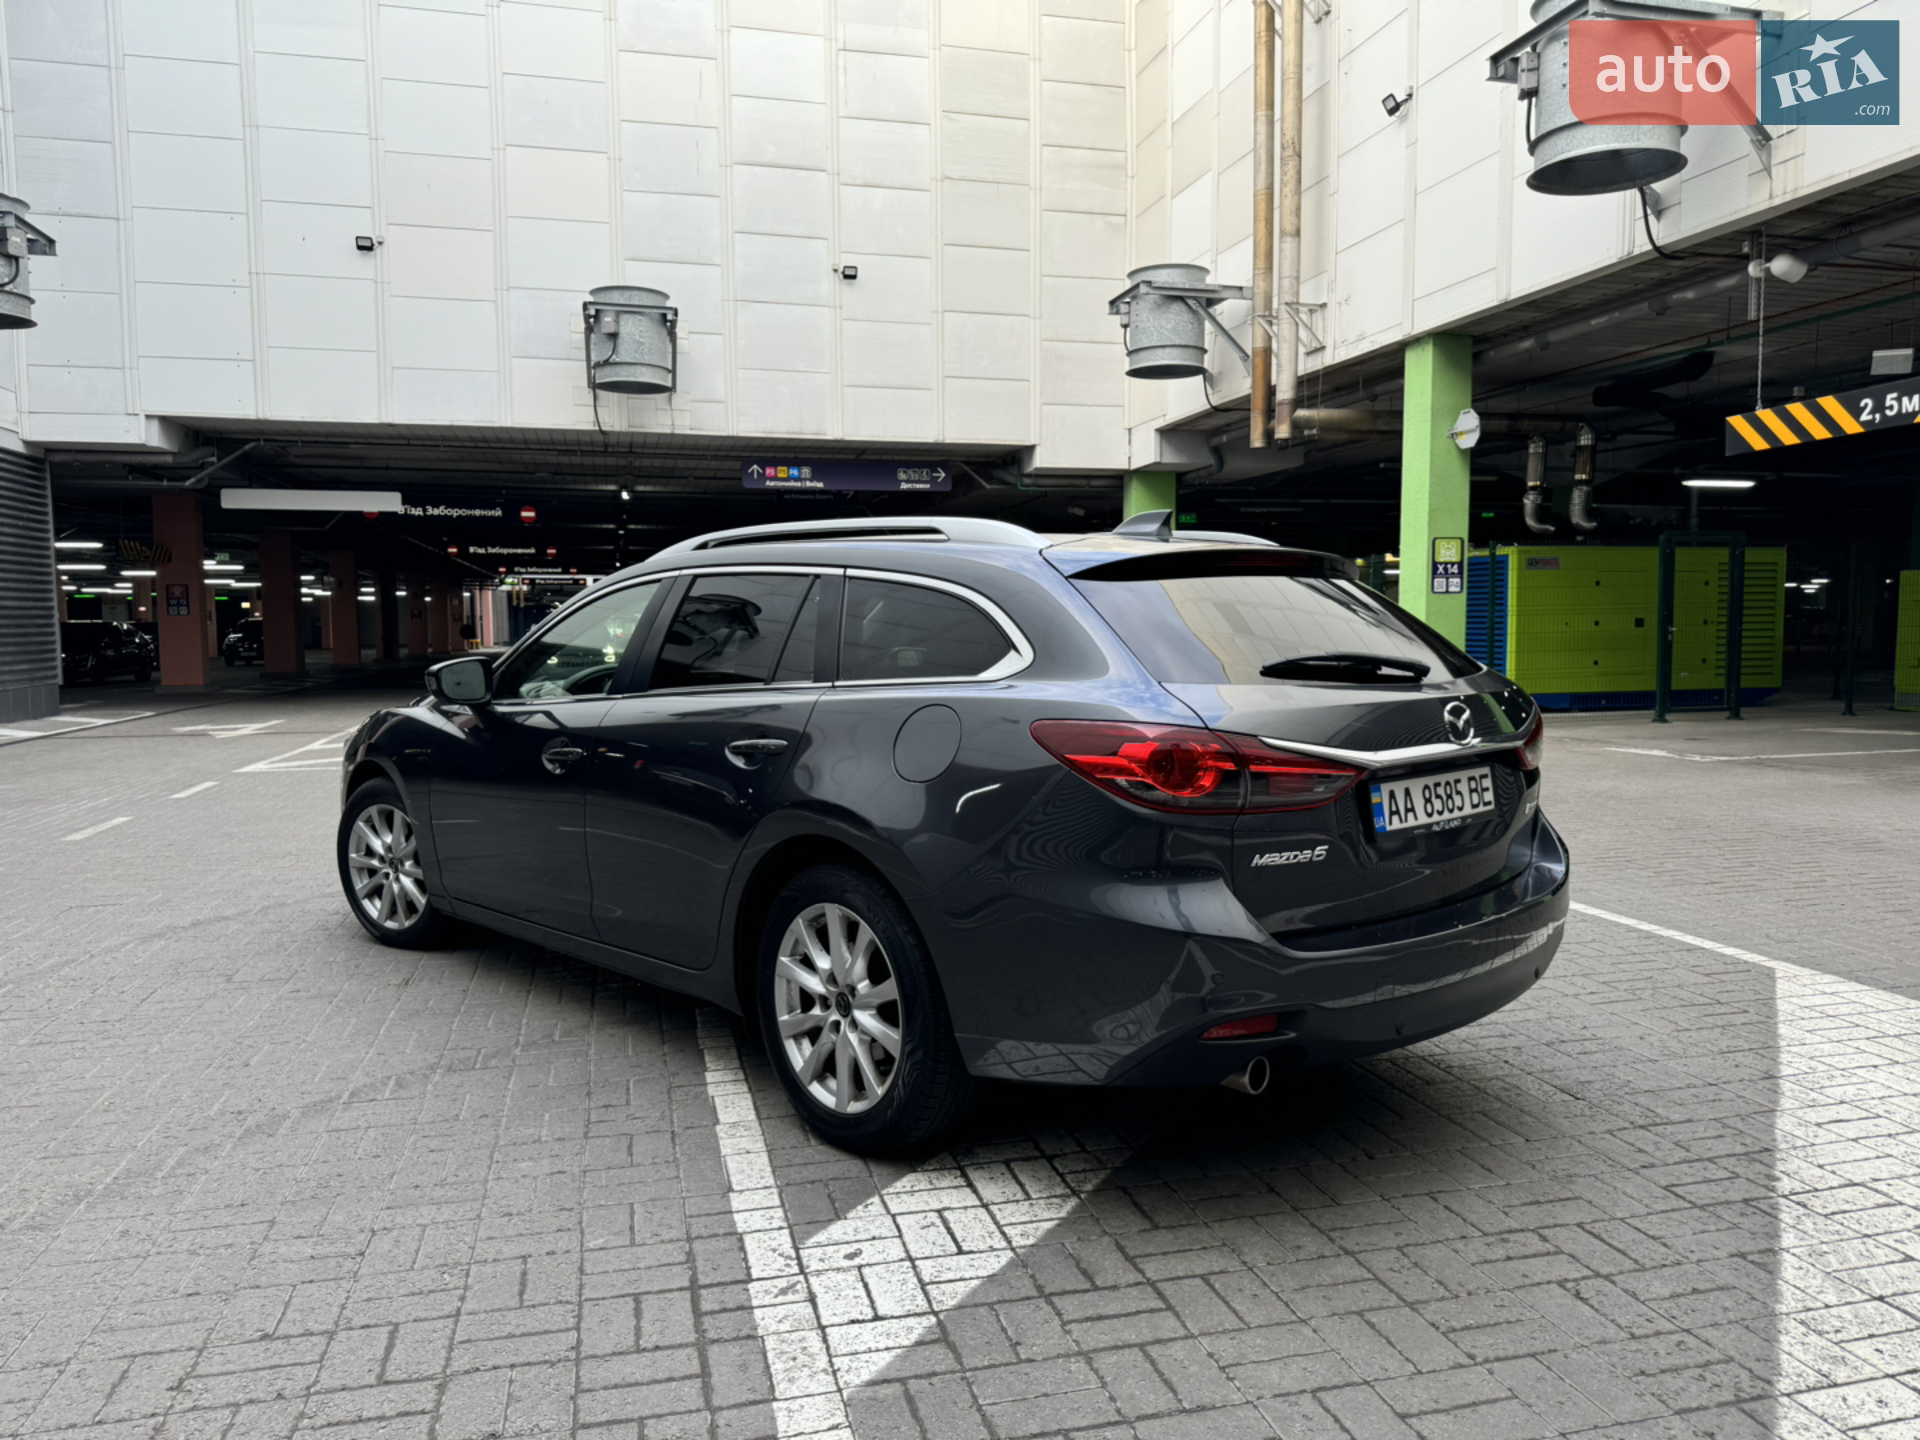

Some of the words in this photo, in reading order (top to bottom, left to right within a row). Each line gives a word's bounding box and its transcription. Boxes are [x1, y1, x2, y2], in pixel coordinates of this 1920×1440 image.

[425, 505, 503, 518] Заборонений
[487, 546, 536, 555] Заборонений
[1446, 563, 1459, 574] 14
[1388, 786, 1419, 826] AA
[1422, 778, 1465, 818] 8585
[1467, 773, 1493, 809] BE
[1374, 816, 1386, 828] UA
